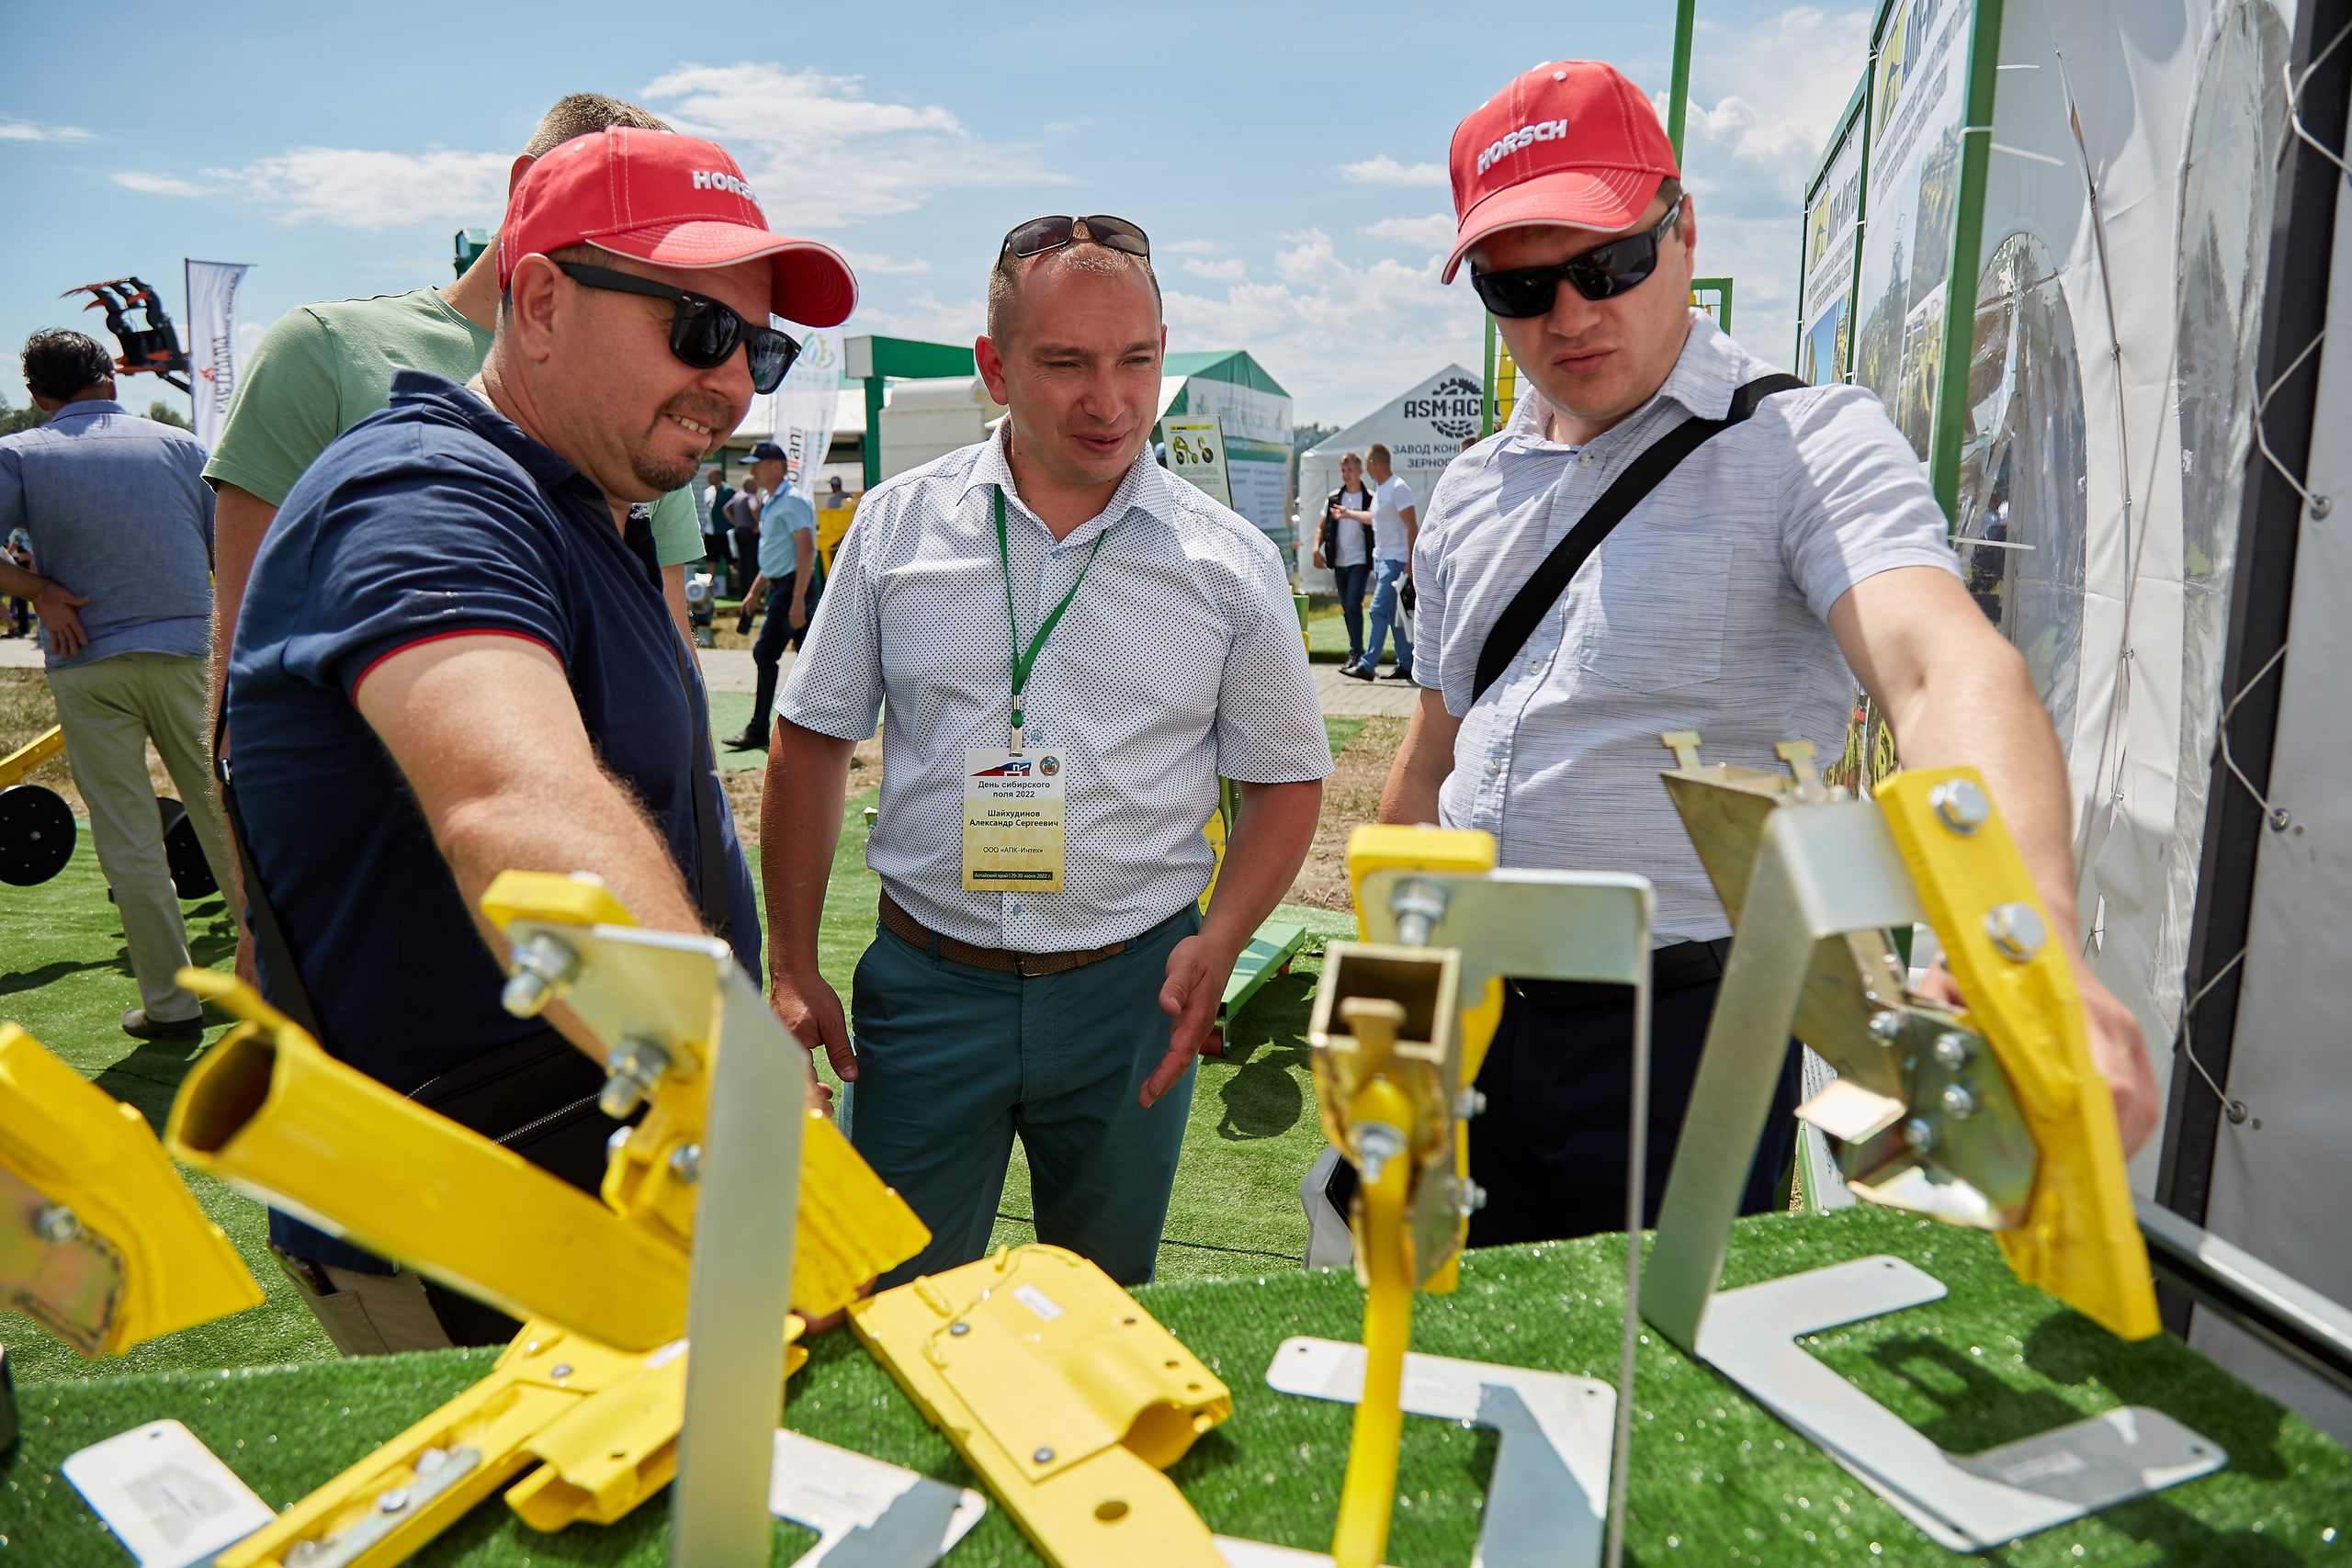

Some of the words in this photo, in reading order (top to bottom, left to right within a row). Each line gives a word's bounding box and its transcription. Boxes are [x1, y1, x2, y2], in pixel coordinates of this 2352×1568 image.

[1477, 118, 1567, 176] HORSCH
[693, 170, 765, 217] HORS
[1393, 444, 1430, 455] ЗАВОД
[978, 780, 1000, 789] День
[1001, 780, 1051, 789] сибирского
[1015, 790, 1035, 798] 2022
[988, 809, 1041, 818] Шайхудинов
[969, 818, 1013, 828] Александр
[1015, 818, 1058, 828] Сергеевич
[1001, 846, 1044, 854] «АПК-Интех»
